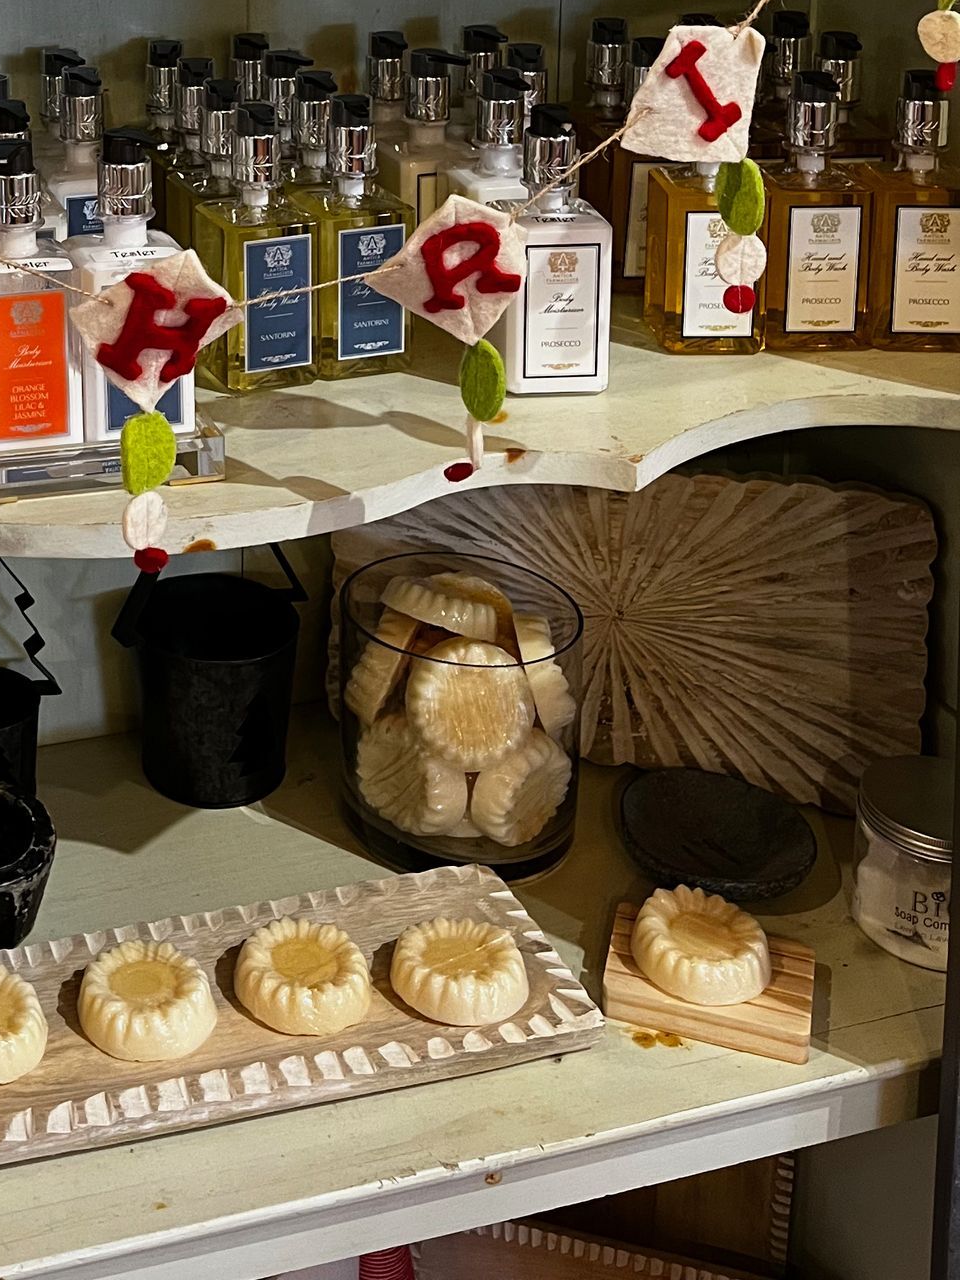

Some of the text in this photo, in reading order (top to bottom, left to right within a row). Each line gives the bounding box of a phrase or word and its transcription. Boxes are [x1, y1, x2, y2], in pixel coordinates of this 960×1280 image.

[800, 251, 847, 262] Hand and
[908, 251, 956, 262] Hand and
[798, 262, 849, 275] Body Wash
[905, 261, 958, 276] Body Wash
[549, 292, 575, 307] Body
[801, 297, 842, 305] PROSECCO
[908, 297, 950, 306] PROSECCO
[353, 319, 390, 329] SANTORINI
[260, 331, 296, 342] SANTORINI
[541, 339, 581, 347] PROSECCO
[15, 345, 41, 358] Body
[12, 384, 47, 393] ORANGE
[10, 393, 49, 402] BLOSSOM
[15, 402, 38, 411] LILAC
[13, 411, 47, 420] JASMINE
[894, 906, 919, 925] Soap
